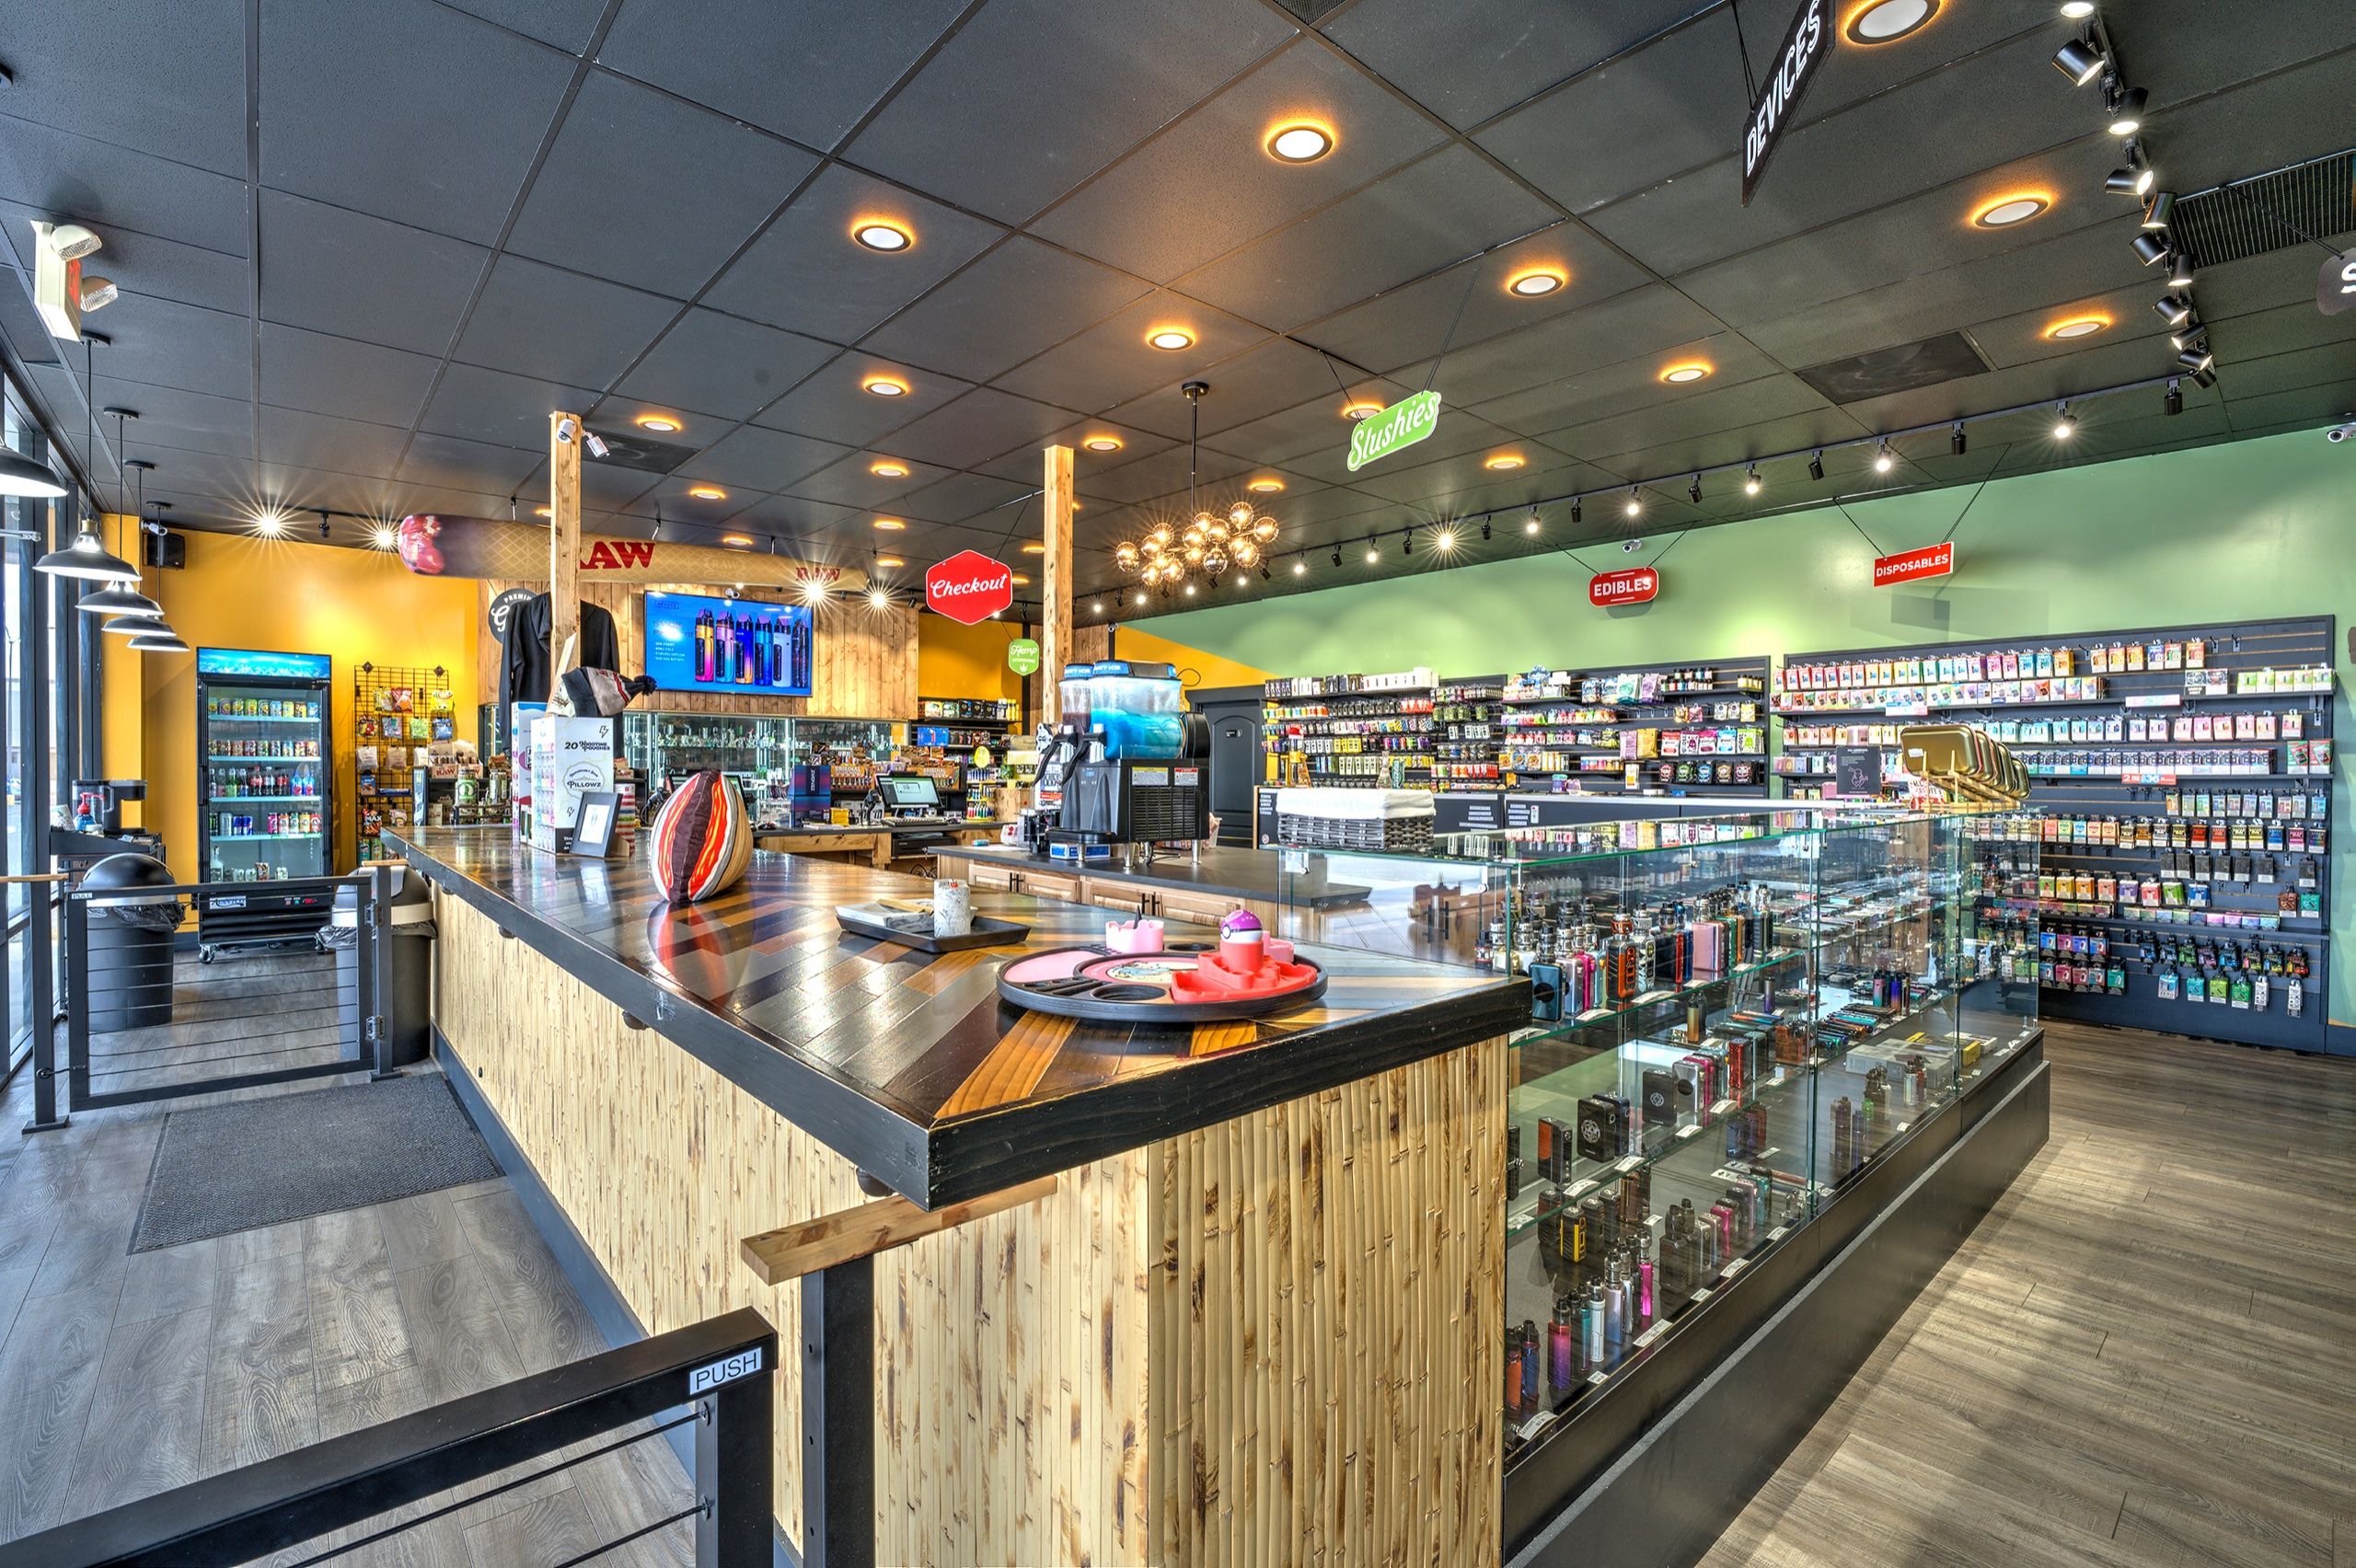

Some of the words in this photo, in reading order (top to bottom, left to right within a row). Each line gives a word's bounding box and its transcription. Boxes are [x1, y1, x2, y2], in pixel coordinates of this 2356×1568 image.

[1746, 0, 1821, 178] DEVICES
[1348, 395, 1438, 467] Slushies
[579, 540, 656, 571] AW
[1876, 553, 1949, 578] DISPOSABLES
[930, 572, 1009, 599] Checkout
[1593, 576, 1653, 597] EDIBLES
[1010, 644, 1038, 657] Hemp
[564, 742, 579, 750] 20
[436, 767, 456, 777] RAW
[566, 779, 602, 789] PILLOWZ
[364, 814, 383, 824] MAX
[696, 1352, 757, 1390] PUSH
